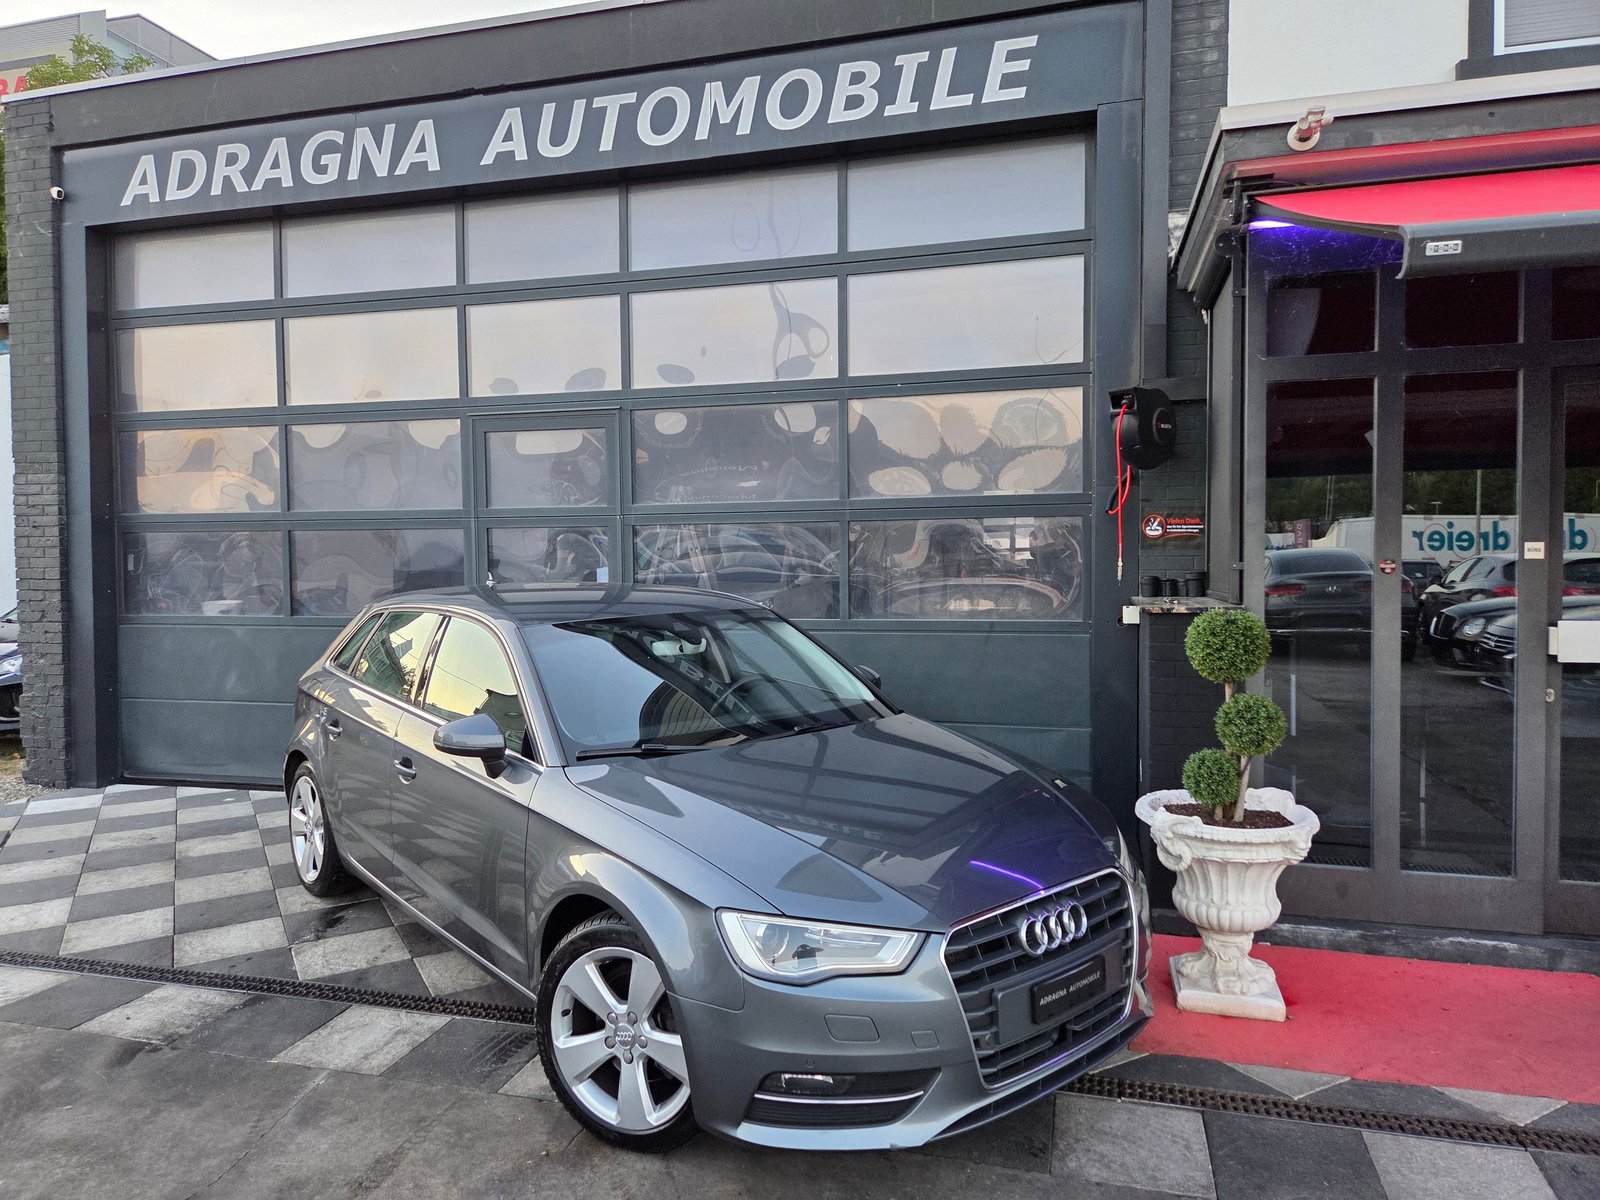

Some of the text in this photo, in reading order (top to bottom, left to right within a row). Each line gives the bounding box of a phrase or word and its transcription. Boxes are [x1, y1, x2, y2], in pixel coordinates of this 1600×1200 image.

[120, 35, 1039, 206] ADRAGNA AUTOMOBILE
[1040, 971, 1101, 1005] ADRAGNA AUTOMOBILE
